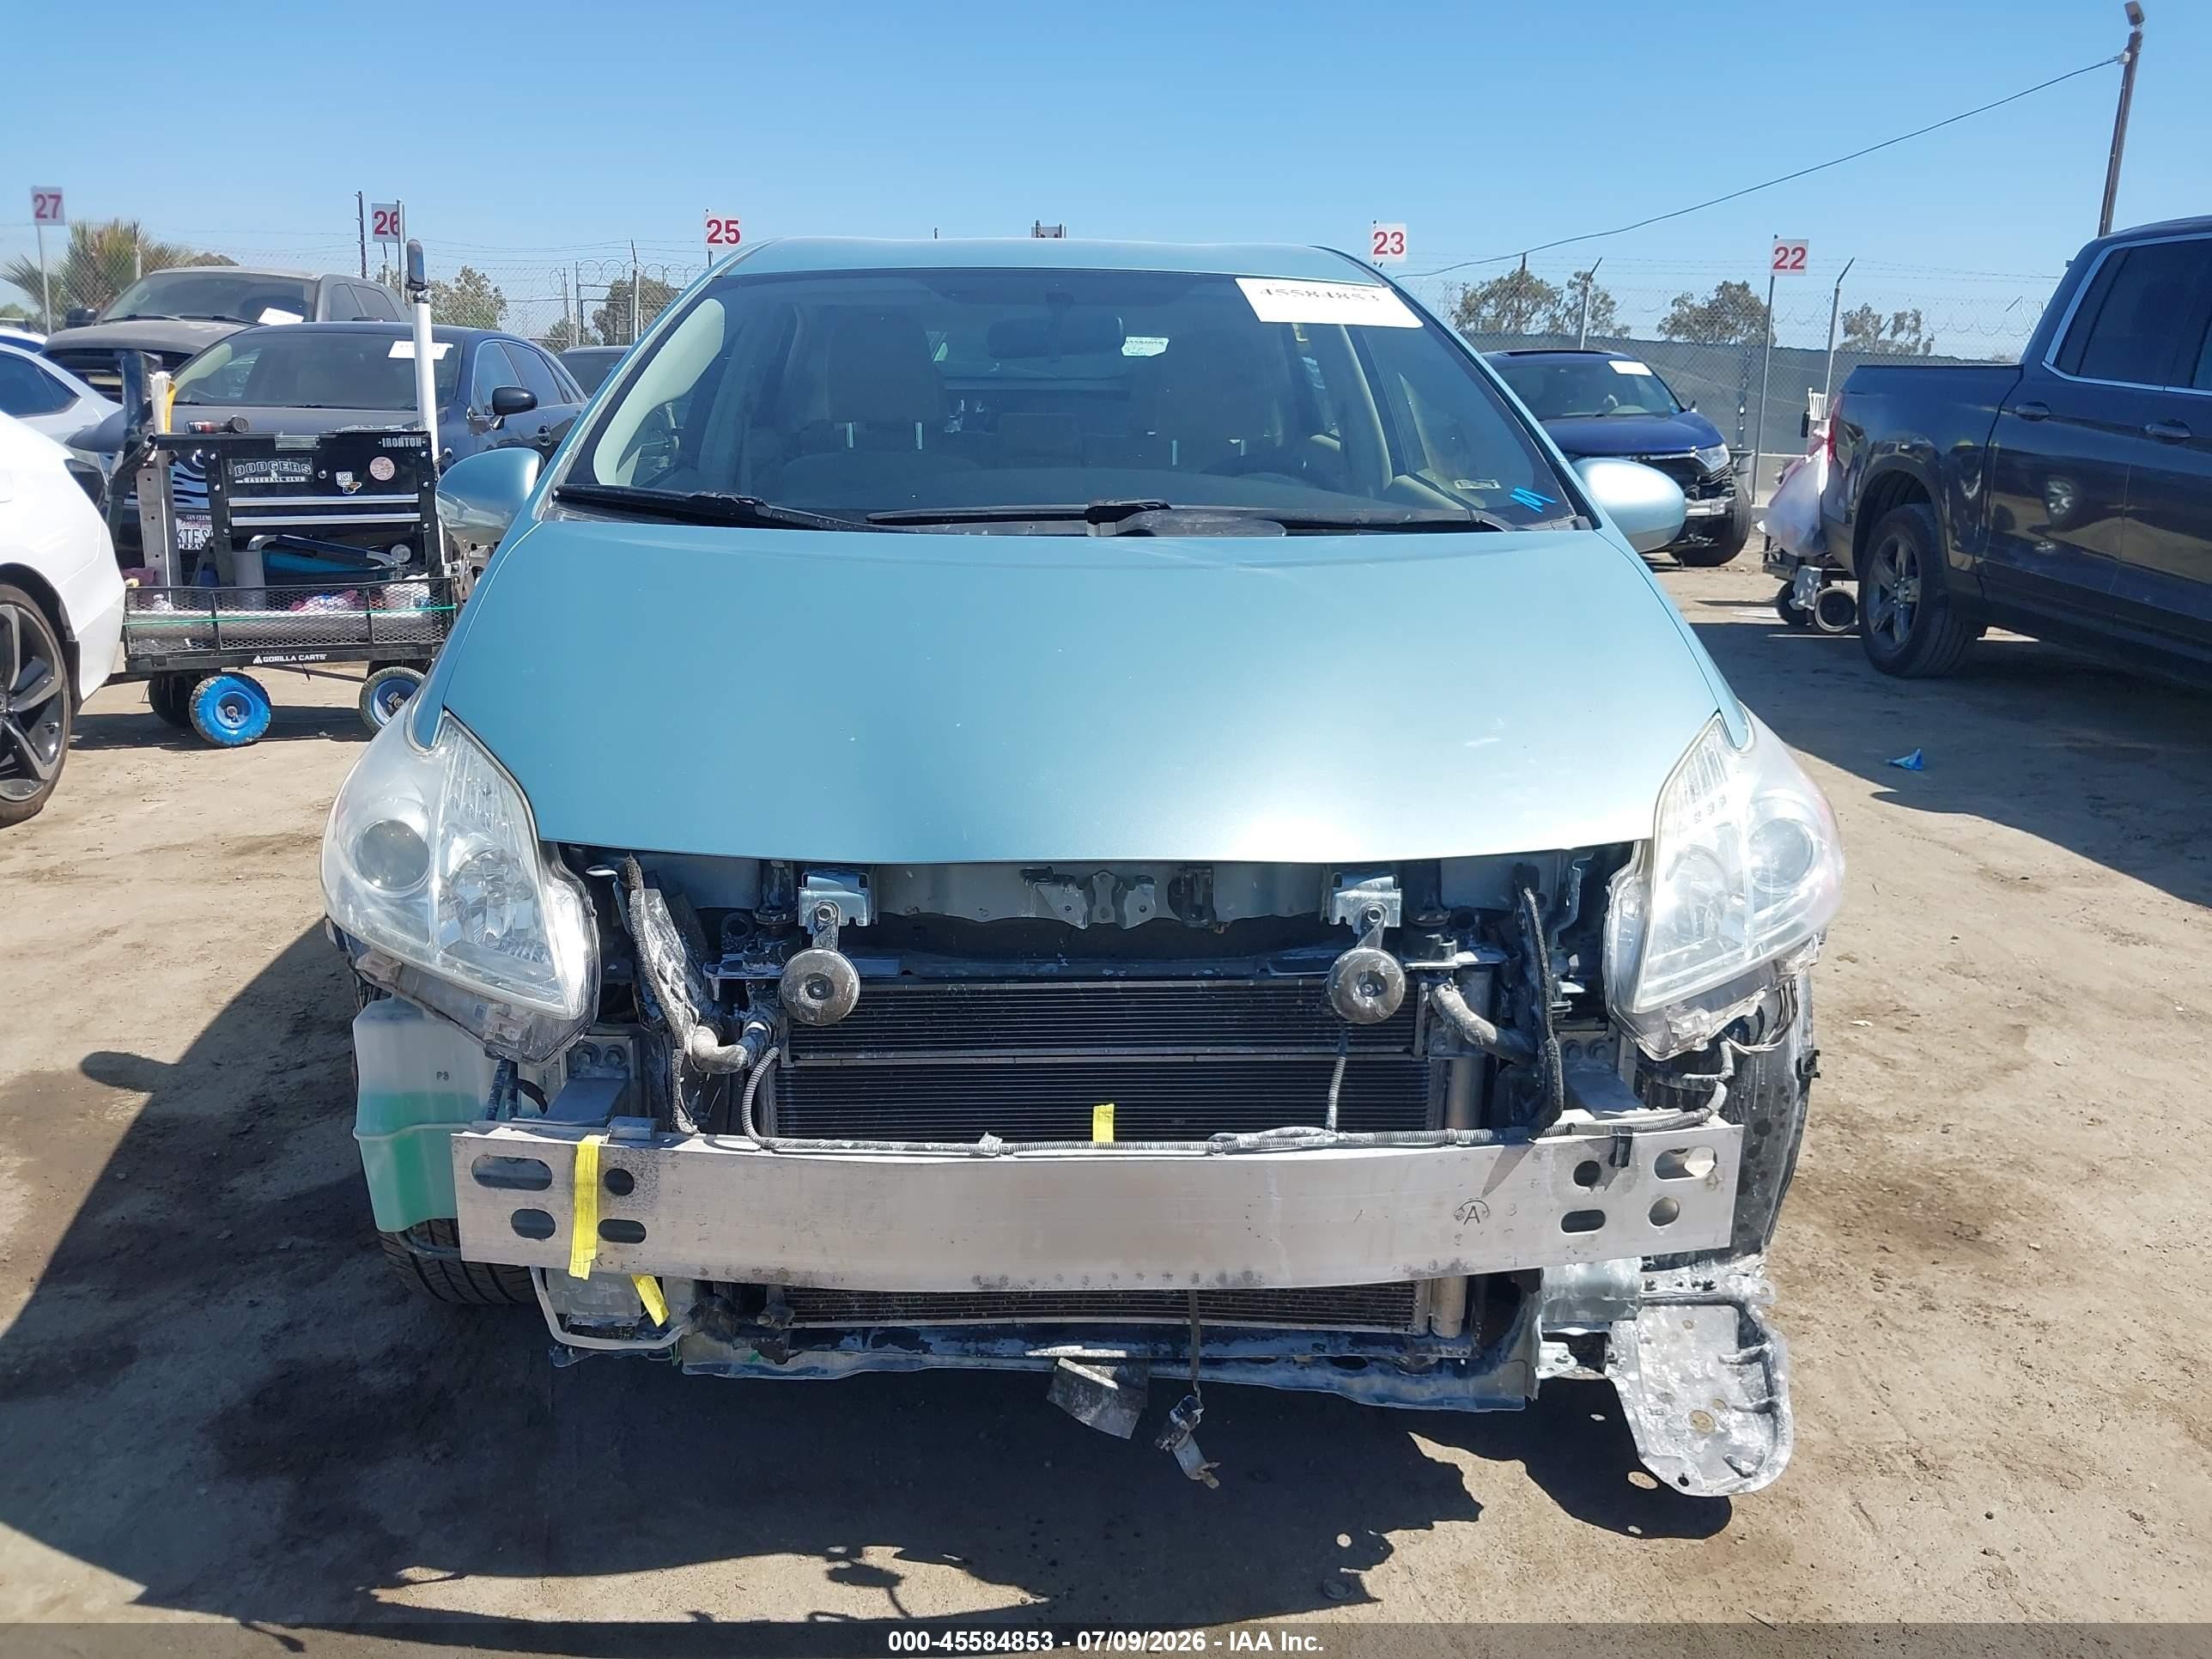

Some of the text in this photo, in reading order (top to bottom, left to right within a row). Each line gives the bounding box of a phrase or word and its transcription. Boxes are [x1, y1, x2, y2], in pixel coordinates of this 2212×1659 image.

[33, 194, 62, 219] 27
[374, 210, 398, 235] 26
[707, 219, 740, 244] 25
[1373, 231, 1405, 255] 23
[1772, 246, 1806, 270] 22
[381, 437, 422, 447] IRONTON
[234, 460, 312, 476] DODGERS
[1463, 1205, 1480, 1225] A
